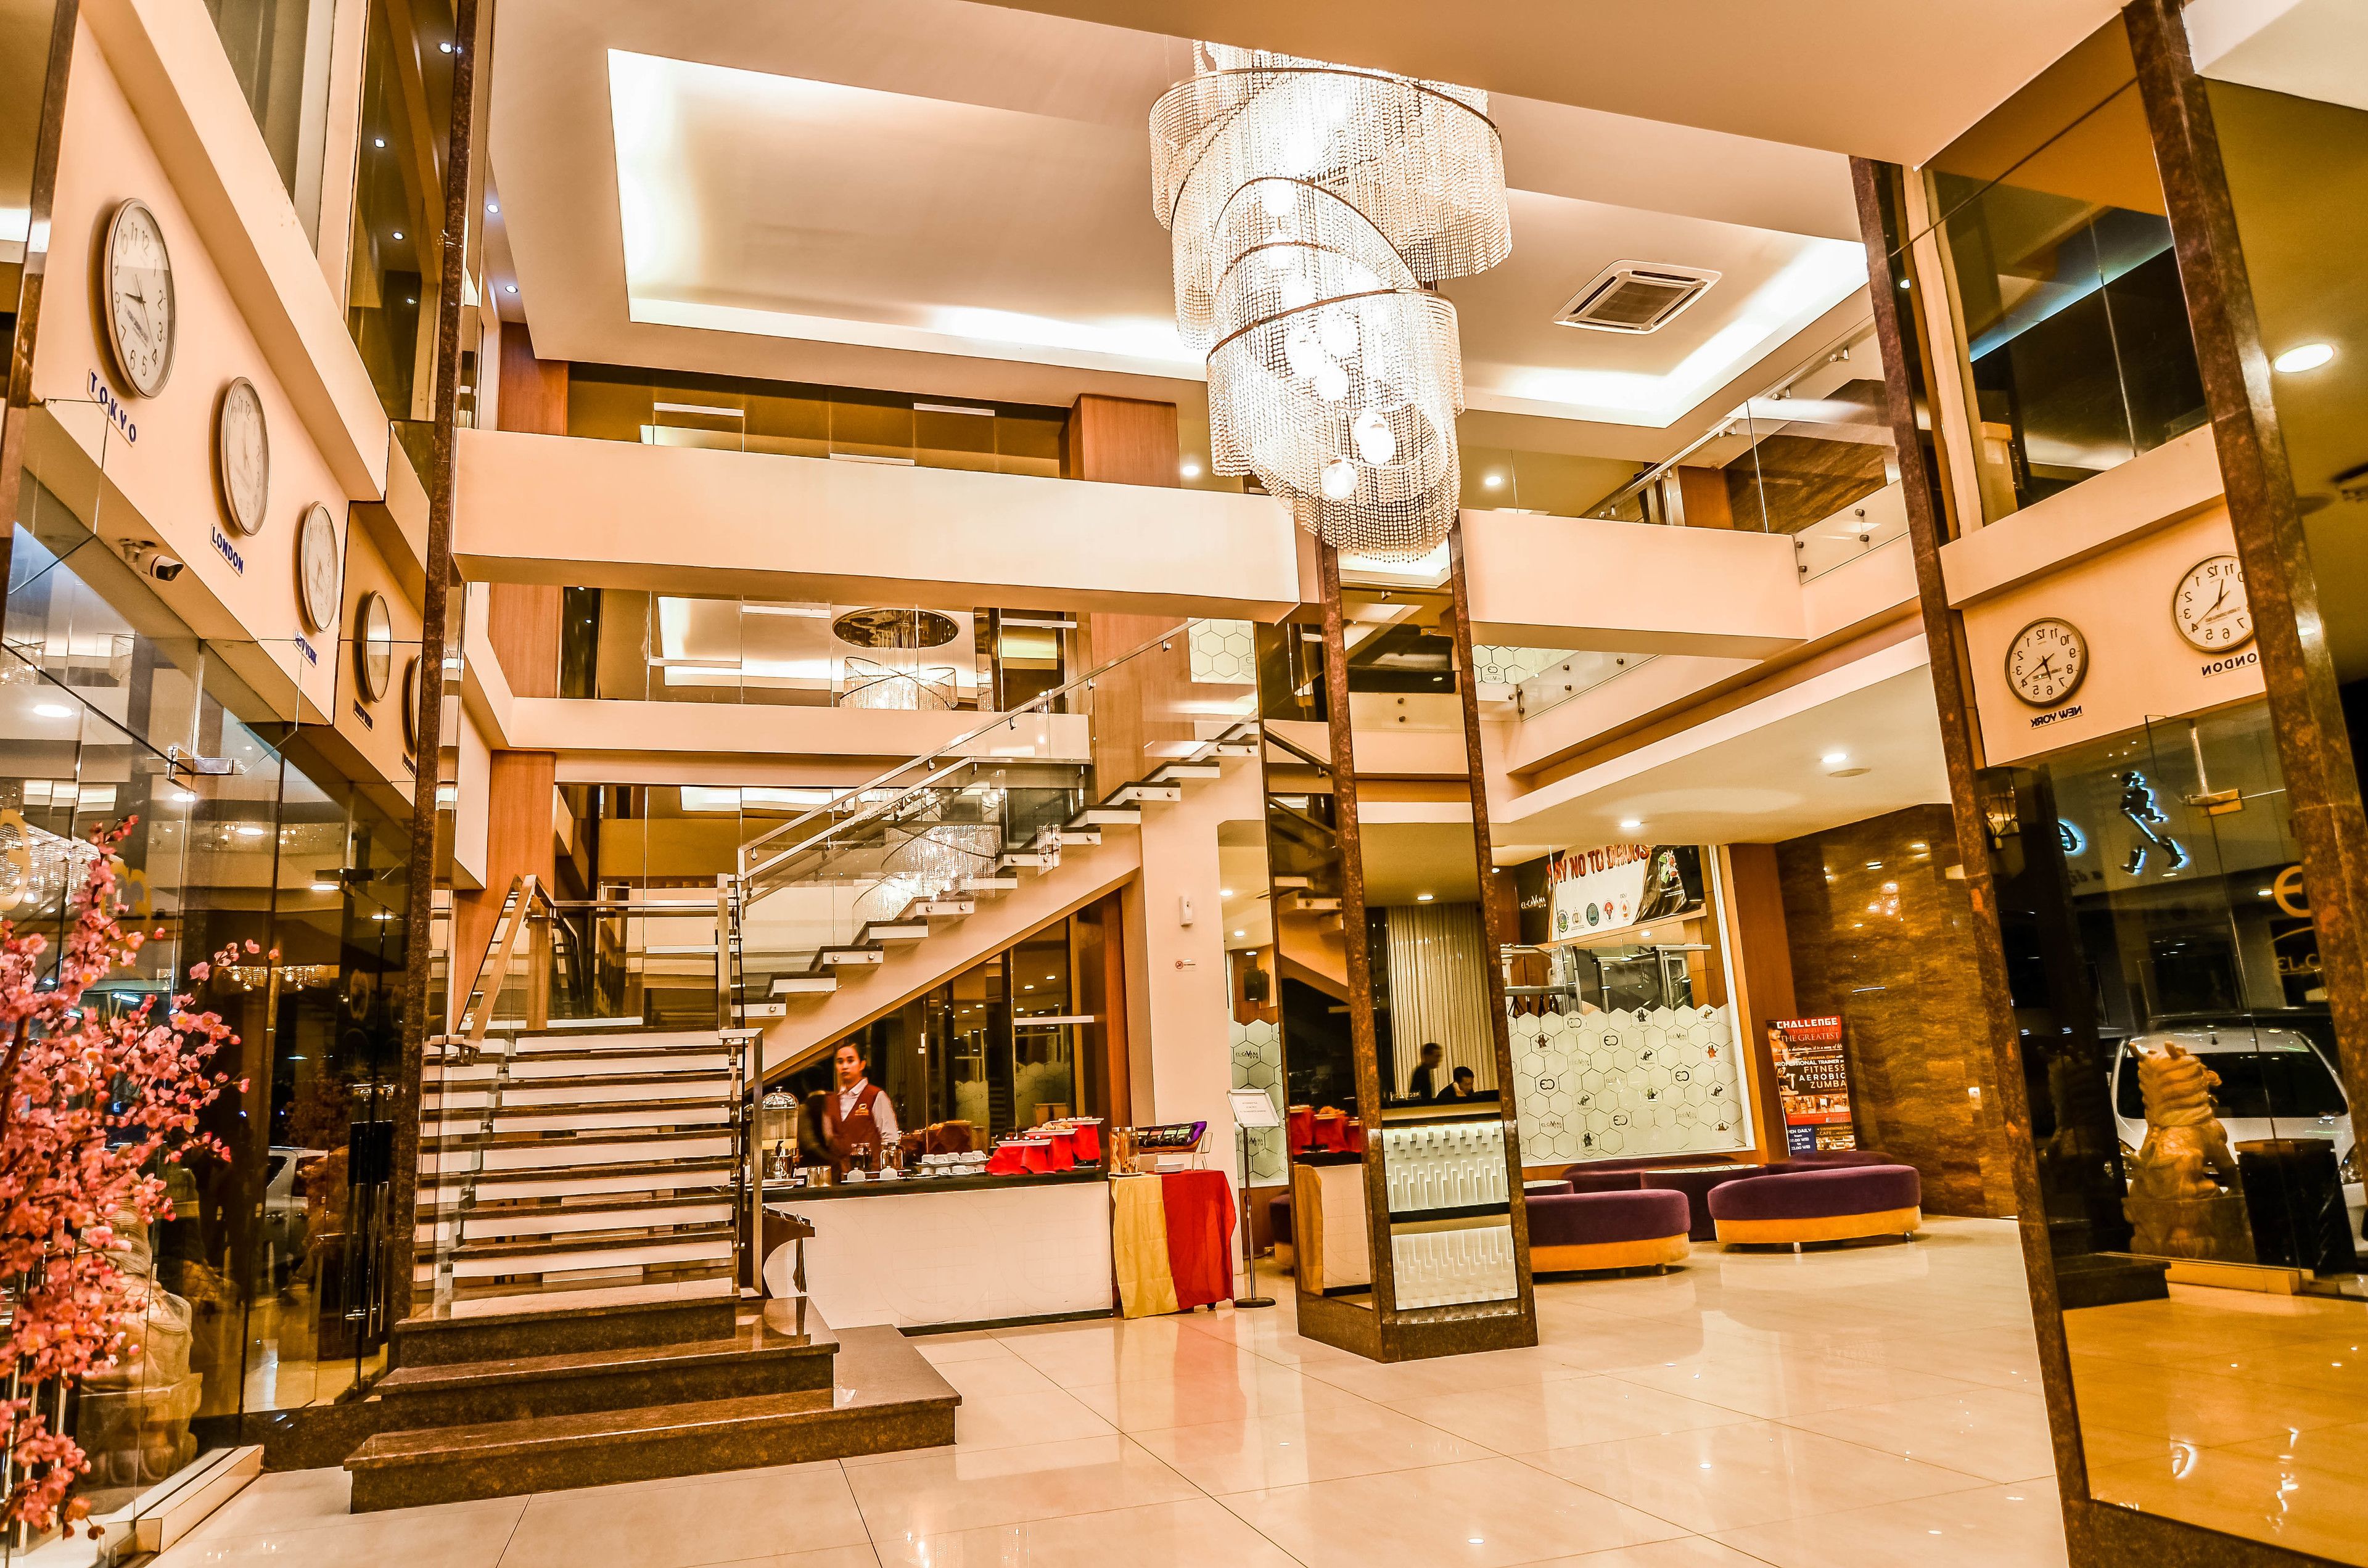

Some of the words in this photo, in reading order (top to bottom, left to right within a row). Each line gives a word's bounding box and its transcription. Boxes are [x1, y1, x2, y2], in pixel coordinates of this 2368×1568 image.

[131, 222, 138, 246] 11
[142, 230, 149, 257] 12
[157, 290, 163, 311] 2
[157, 321, 163, 342] 3
[130, 349, 136, 370] 6
[141, 355, 147, 376] 5
[91, 371, 136, 443] TOKYO
[212, 526, 244, 574] LONDON
[1546, 859, 1567, 884] SAY
[1569, 853, 1587, 880] NO
[1587, 848, 1605, 874] TO
[1606, 844, 1650, 869] DRUGS
[1777, 1017, 1838, 1029] CHALLENGE
[1798, 1032, 1840, 1041] GREATEST
[1799, 1072, 1846, 1082] AEROBIC
[1804, 1064, 1844, 1073] FITNESS
[1810, 1080, 1846, 1089] ZUMBA
